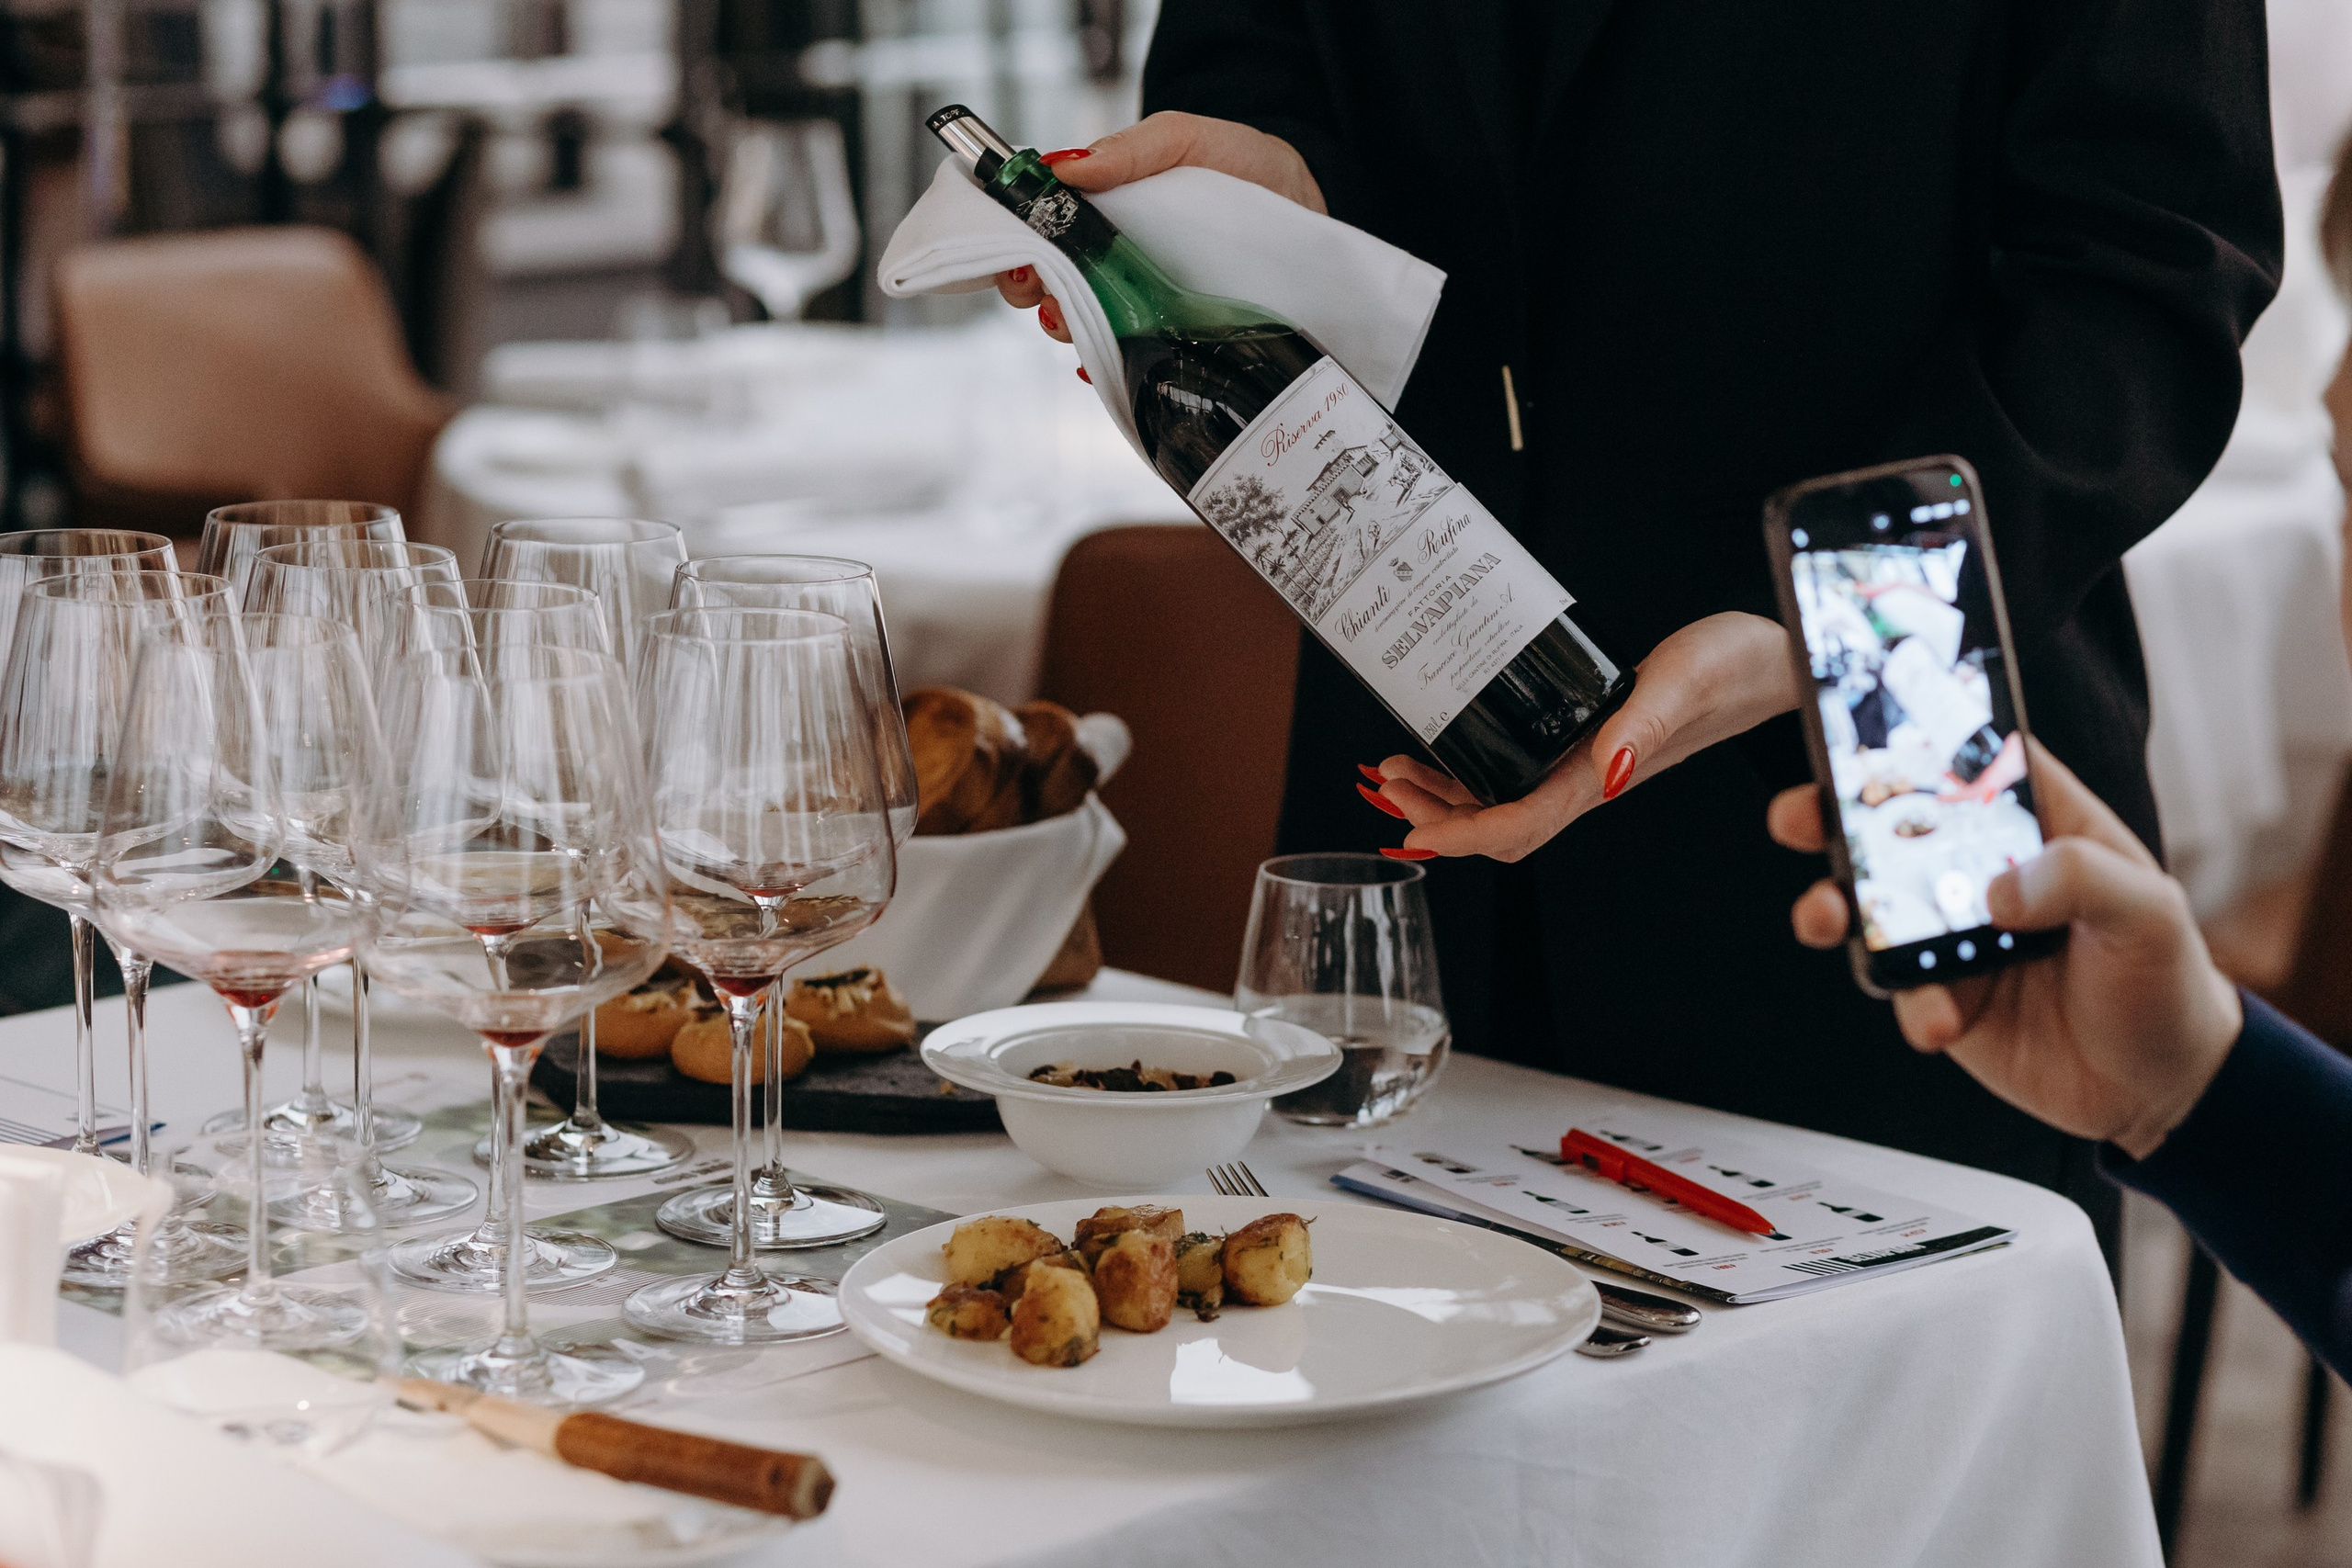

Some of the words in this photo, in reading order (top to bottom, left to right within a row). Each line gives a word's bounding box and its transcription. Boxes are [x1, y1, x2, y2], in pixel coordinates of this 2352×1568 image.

[1261, 410, 1322, 467] Riserva
[1324, 382, 1350, 412] 1980
[1334, 584, 1390, 643] Chianti
[1417, 513, 1471, 564] Rufina
[1381, 552, 1502, 671] SELVAPIANA
[1408, 575, 1452, 618] FATTORIA
[1418, 650, 1457, 691] Francesco
[1467, 659, 1487, 679] CANTINE
[1491, 638, 1509, 656] RUFINA
[1510, 624, 1523, 637] ITALIA
